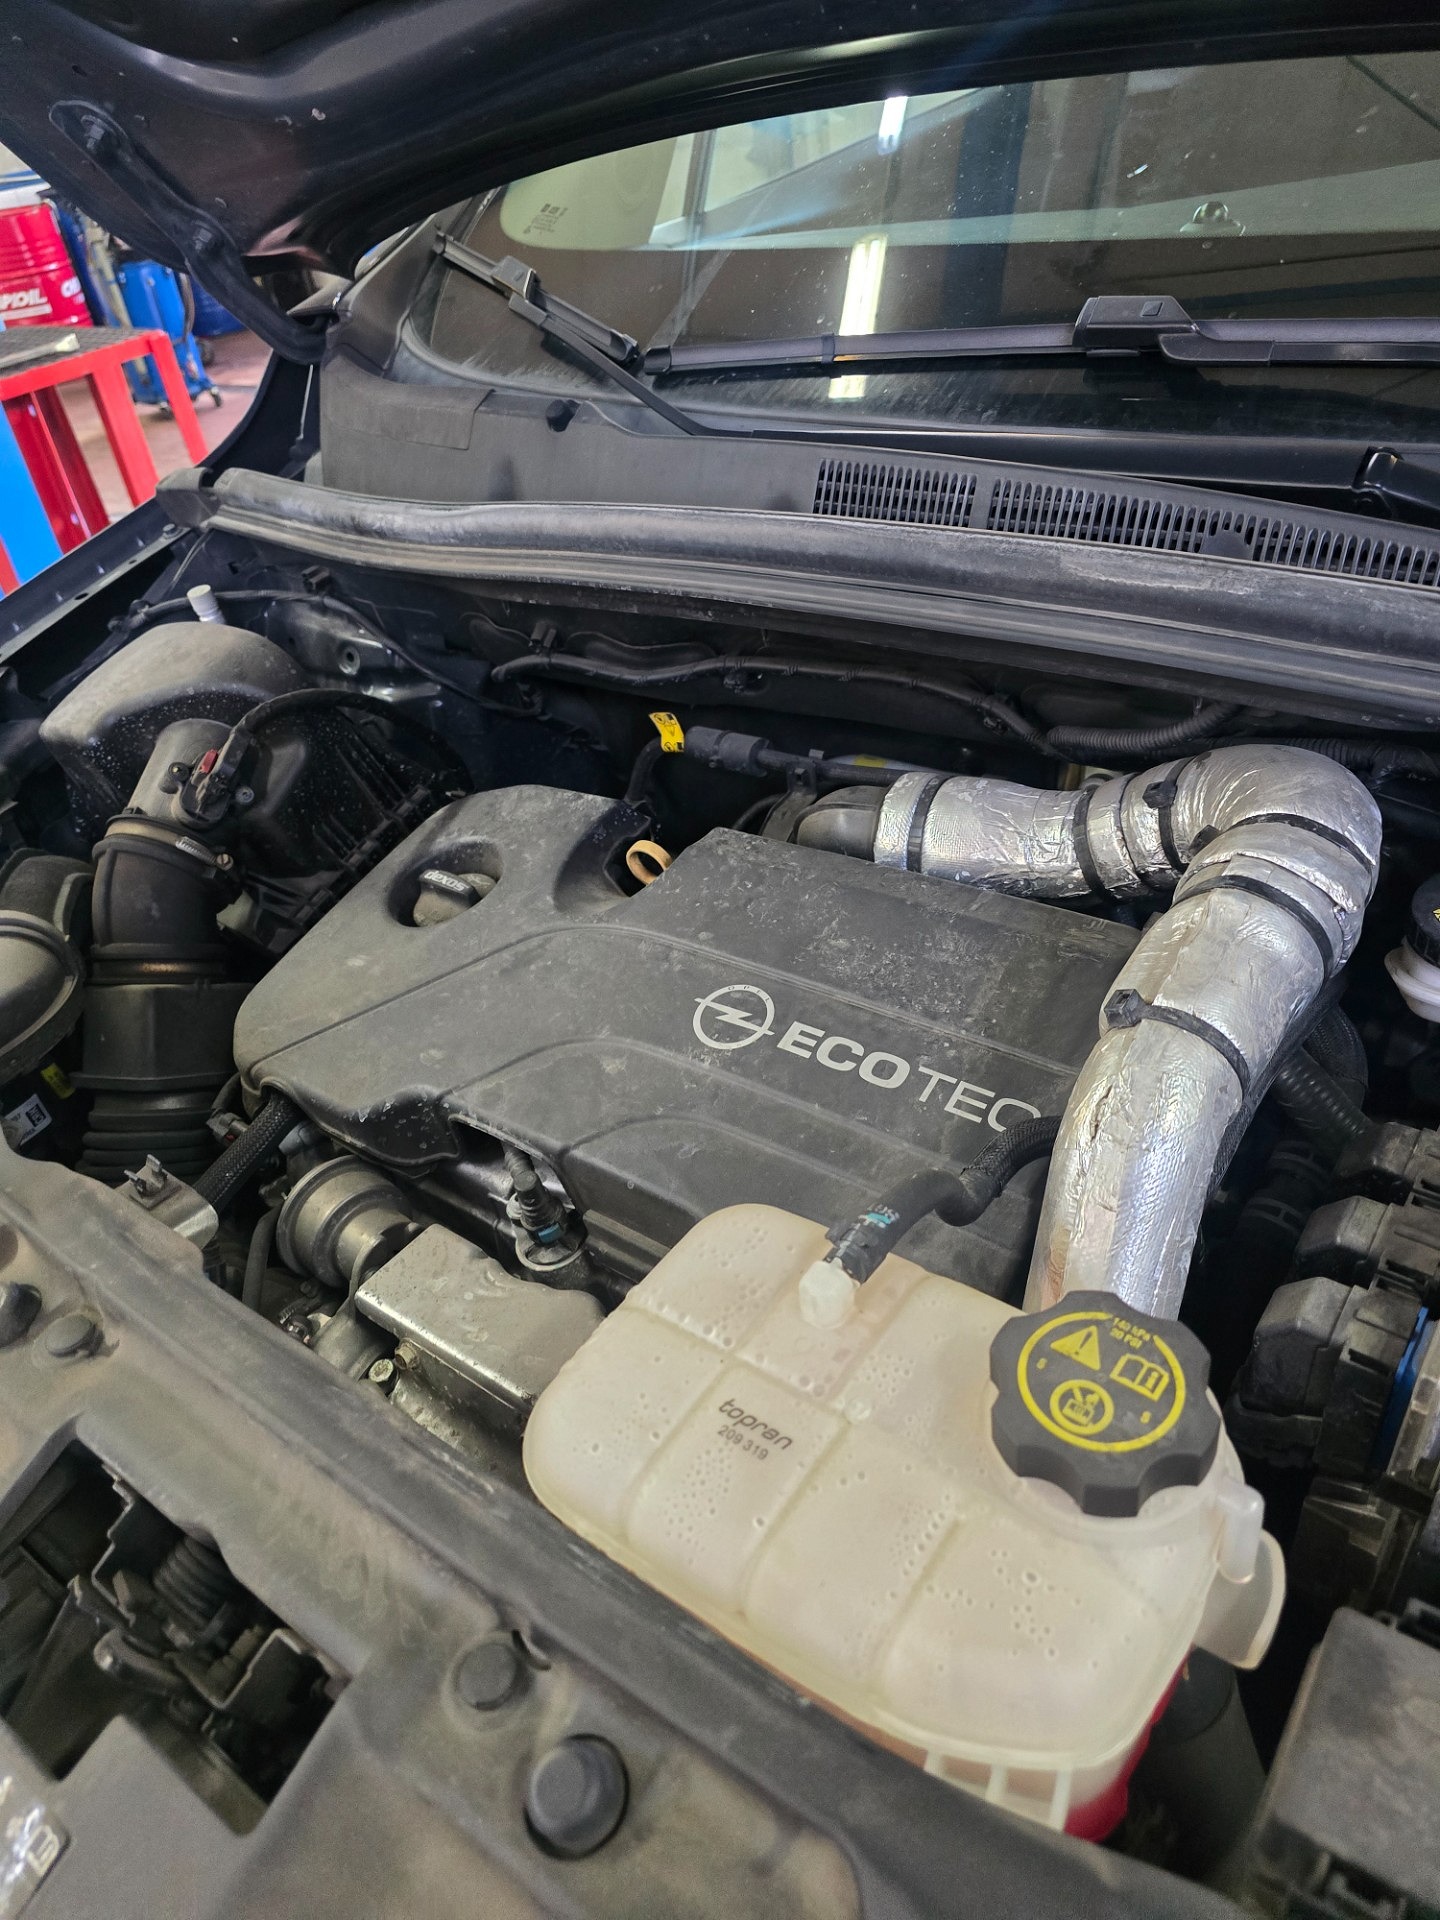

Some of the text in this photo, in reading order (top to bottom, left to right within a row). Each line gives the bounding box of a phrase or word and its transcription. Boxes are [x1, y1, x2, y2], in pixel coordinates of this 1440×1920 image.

[423, 870, 469, 892] dexos
[776, 1020, 1042, 1133] ECOTEC
[717, 1424, 769, 1461] 209 319
[718, 1398, 793, 1450] topran
